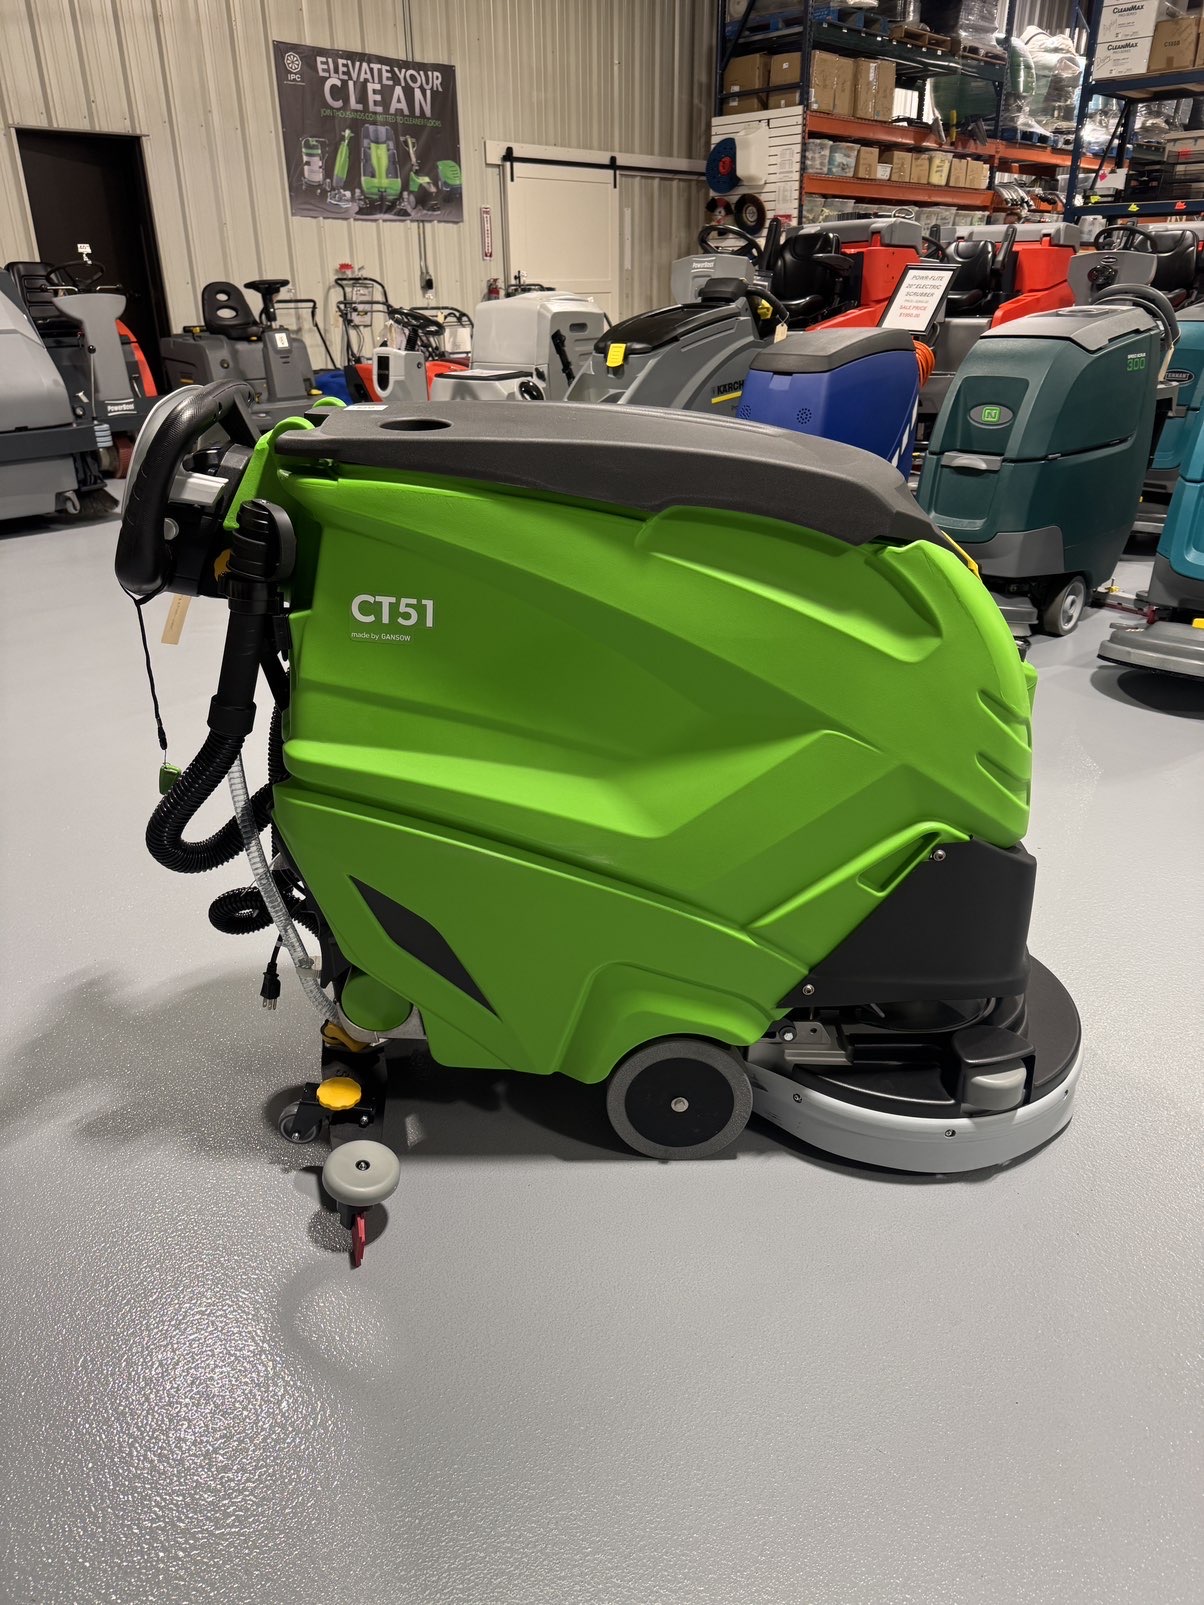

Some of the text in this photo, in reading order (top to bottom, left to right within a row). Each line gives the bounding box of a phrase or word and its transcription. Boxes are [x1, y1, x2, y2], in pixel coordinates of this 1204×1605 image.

[316, 56, 443, 92] ELEVATE YOUR
[323, 77, 432, 117] CLEAN
[320, 108, 333, 117] JOIN
[333, 110, 365, 120] THOUSANDS
[1127, 358, 1146, 371] 300
[717, 379, 745, 395] KÄRCH
[351, 594, 434, 628] CT51
[370, 632, 380, 641] by
[381, 633, 411, 641] GANSOW
